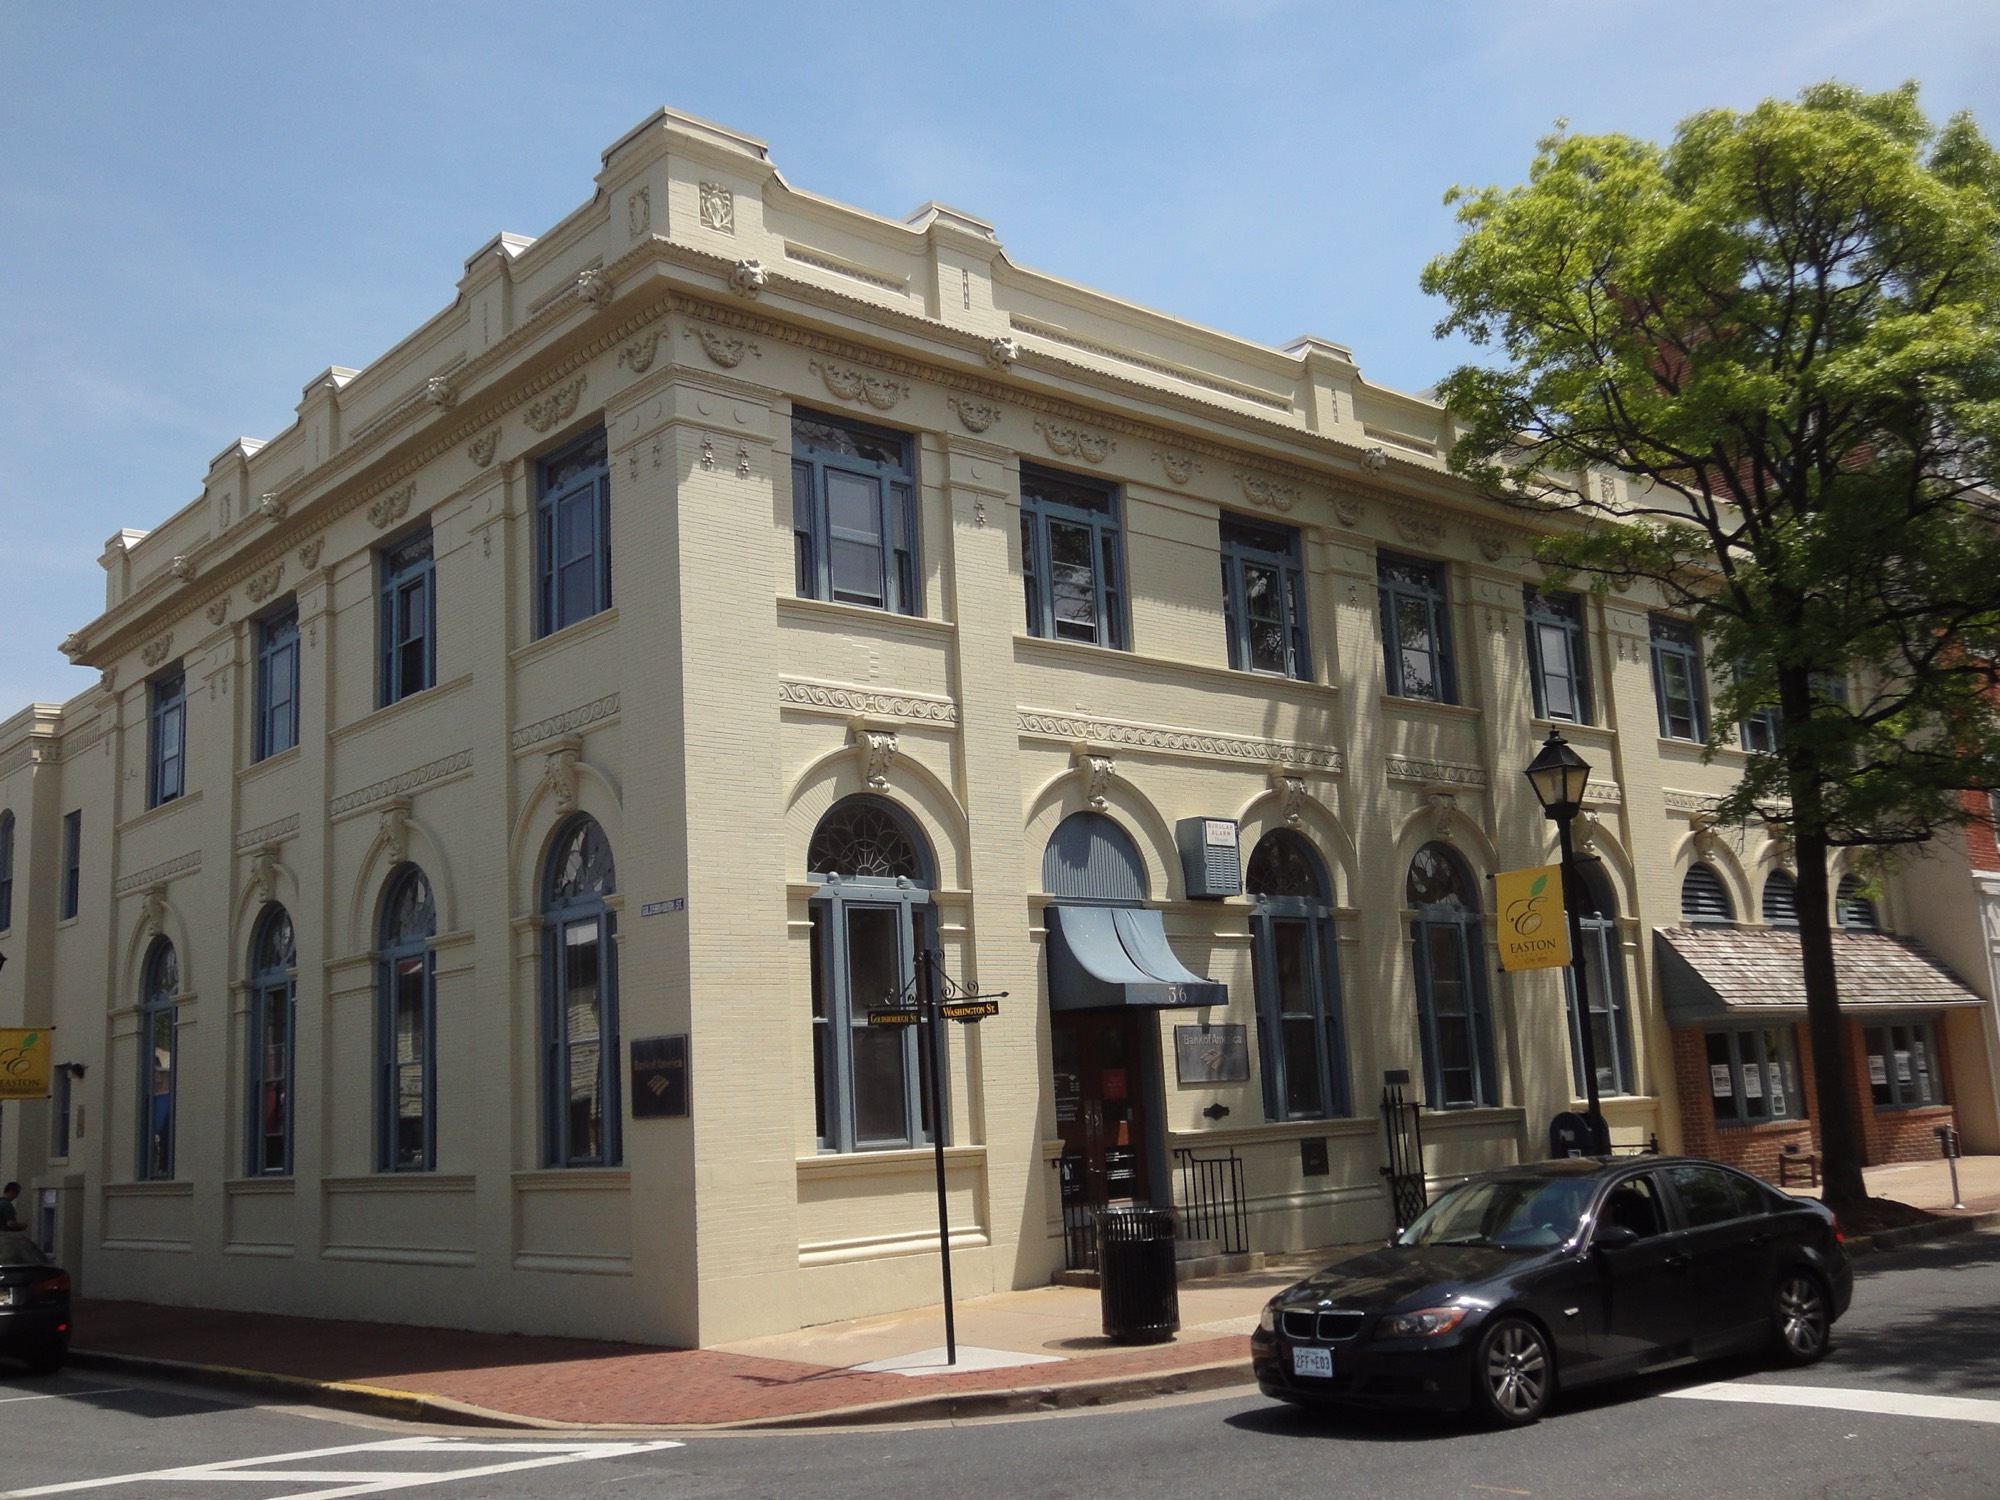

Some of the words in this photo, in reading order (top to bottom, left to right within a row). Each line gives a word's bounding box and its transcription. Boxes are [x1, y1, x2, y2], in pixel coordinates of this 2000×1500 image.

[1510, 939, 1556, 954] EASTON
[1168, 987, 1187, 1003] 36
[943, 1006, 985, 1017] WASHINGTON
[1184, 1035, 1203, 1045] Bank
